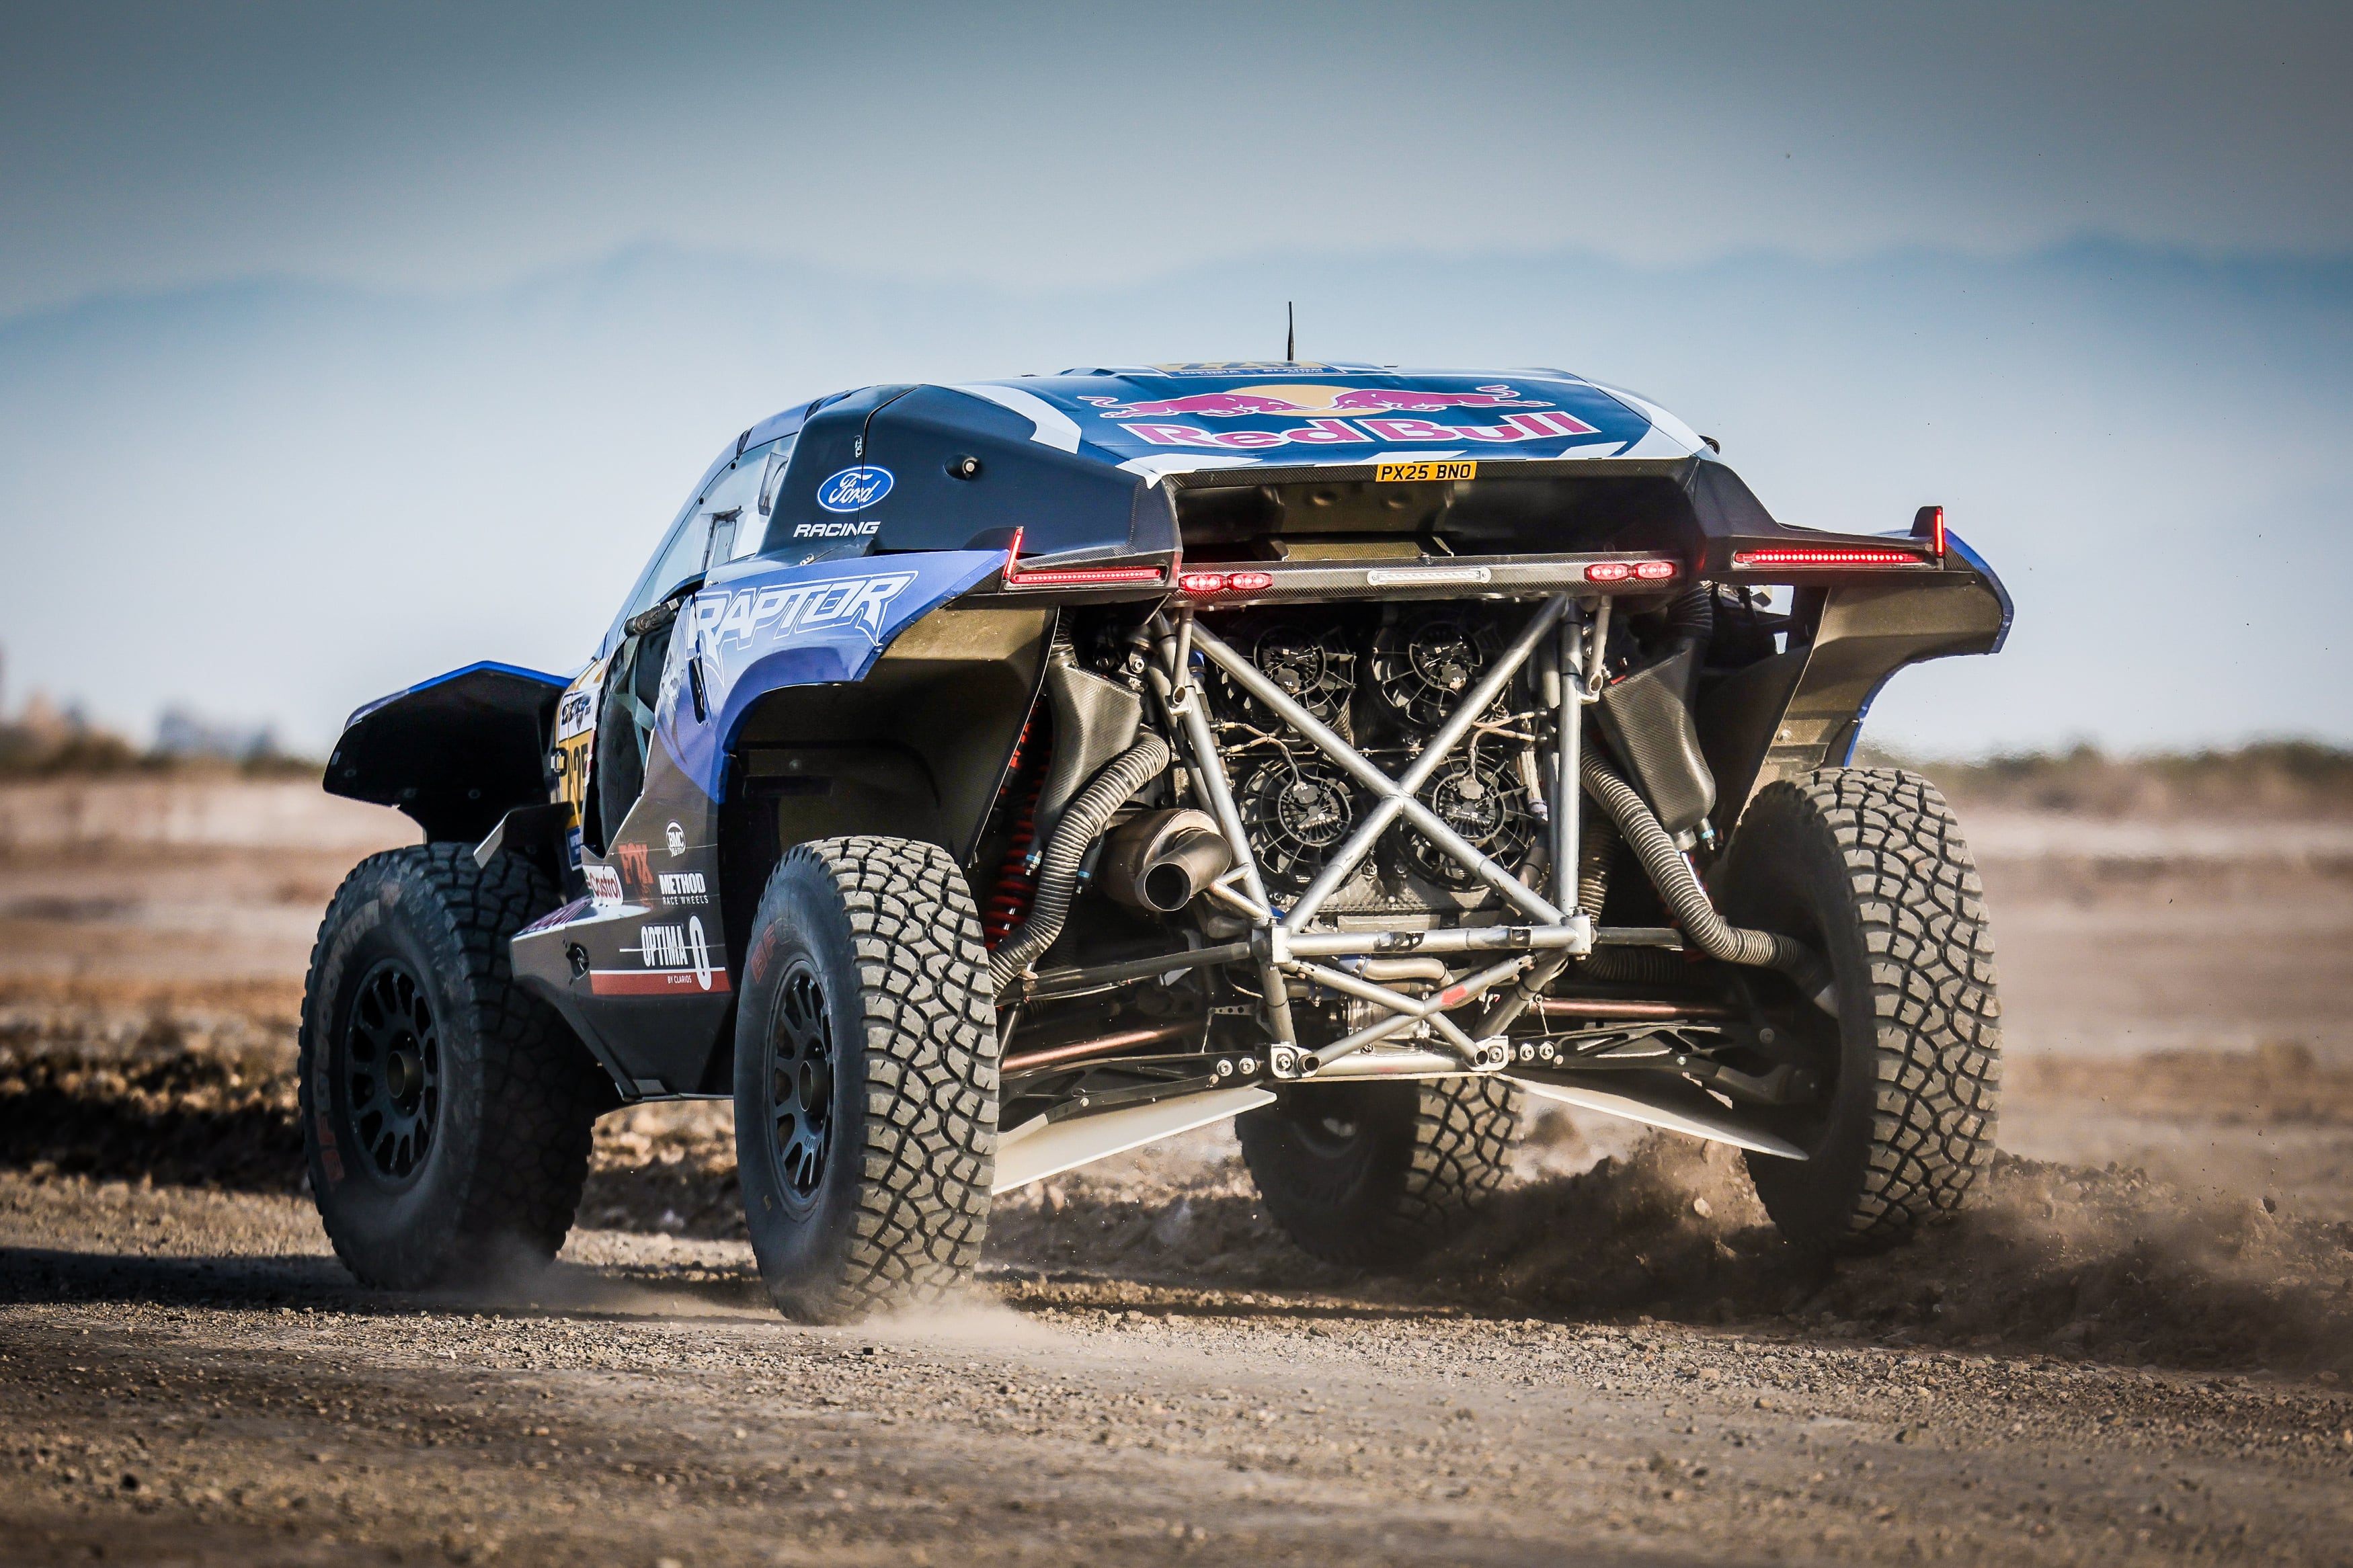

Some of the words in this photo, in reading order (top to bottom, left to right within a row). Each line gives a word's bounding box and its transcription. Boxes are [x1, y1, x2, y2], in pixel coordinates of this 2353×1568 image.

[1117, 418, 1377, 449] Red
[1353, 411, 1603, 441] Bull
[1381, 464, 1429, 481] PX25
[1435, 464, 1471, 479] BNO
[828, 472, 881, 504] Ford
[793, 521, 881, 538] RACING
[684, 570, 920, 689] RAPTOR
[668, 831, 684, 848] BMC
[618, 841, 654, 884] FOX
[589, 872, 621, 899] Castrol
[658, 872, 706, 895] METHOD
[662, 896, 679, 905] RACE
[680, 895, 709, 905] WHEELS
[641, 925, 688, 967] OPTIMA
[667, 976, 673, 984] BY
[674, 975, 692, 984] CLARIOS
